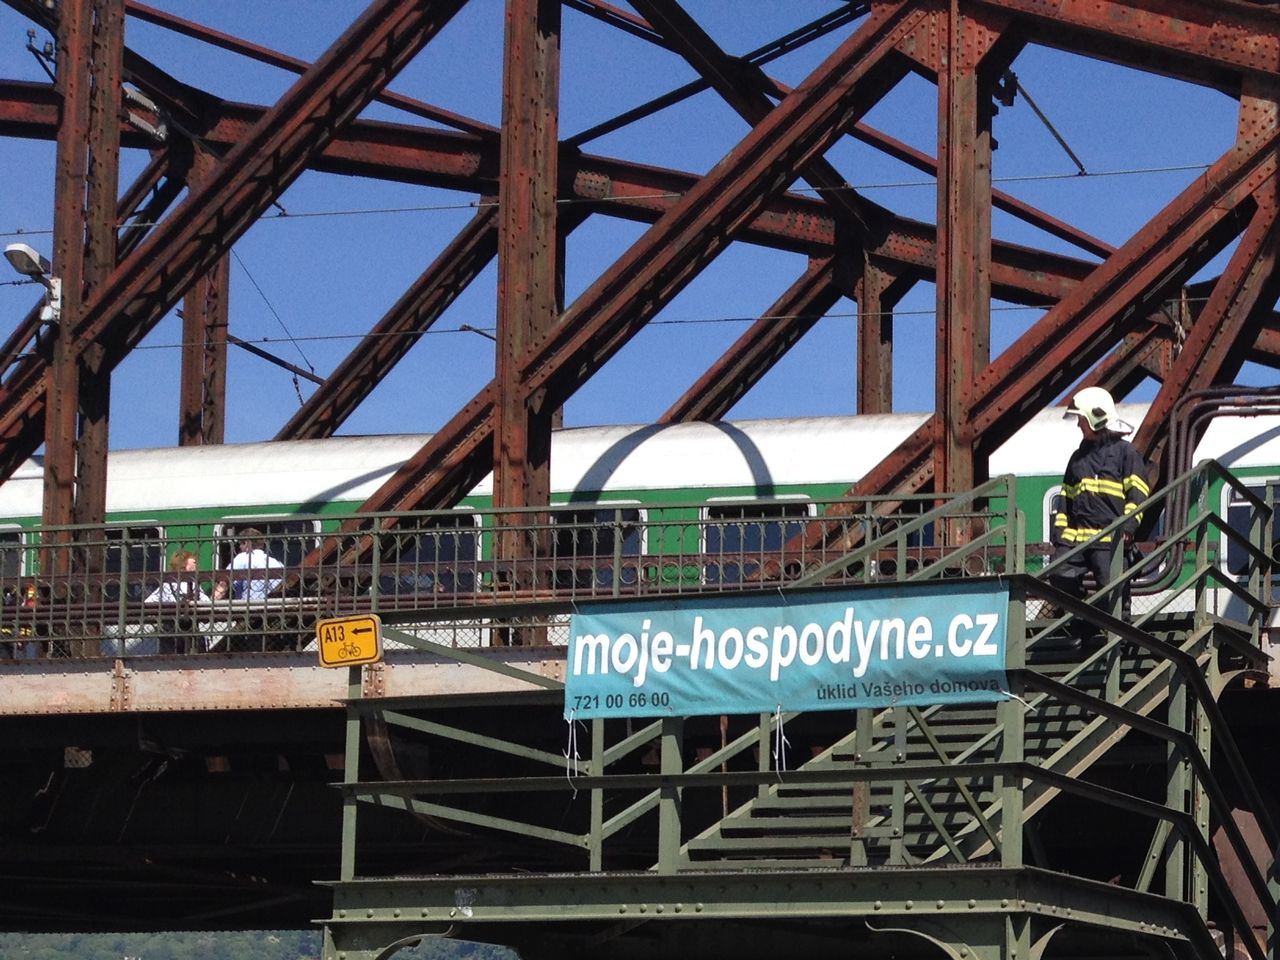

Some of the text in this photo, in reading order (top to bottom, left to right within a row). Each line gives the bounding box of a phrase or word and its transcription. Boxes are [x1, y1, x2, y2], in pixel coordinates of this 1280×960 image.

[324, 625, 345, 644] A13
[573, 607, 999, 688] moje-hospodyne.cz
[861, 681, 924, 698] Vašeho
[929, 678, 1000, 694] domova
[574, 692, 669, 710] 721 00 66 00
